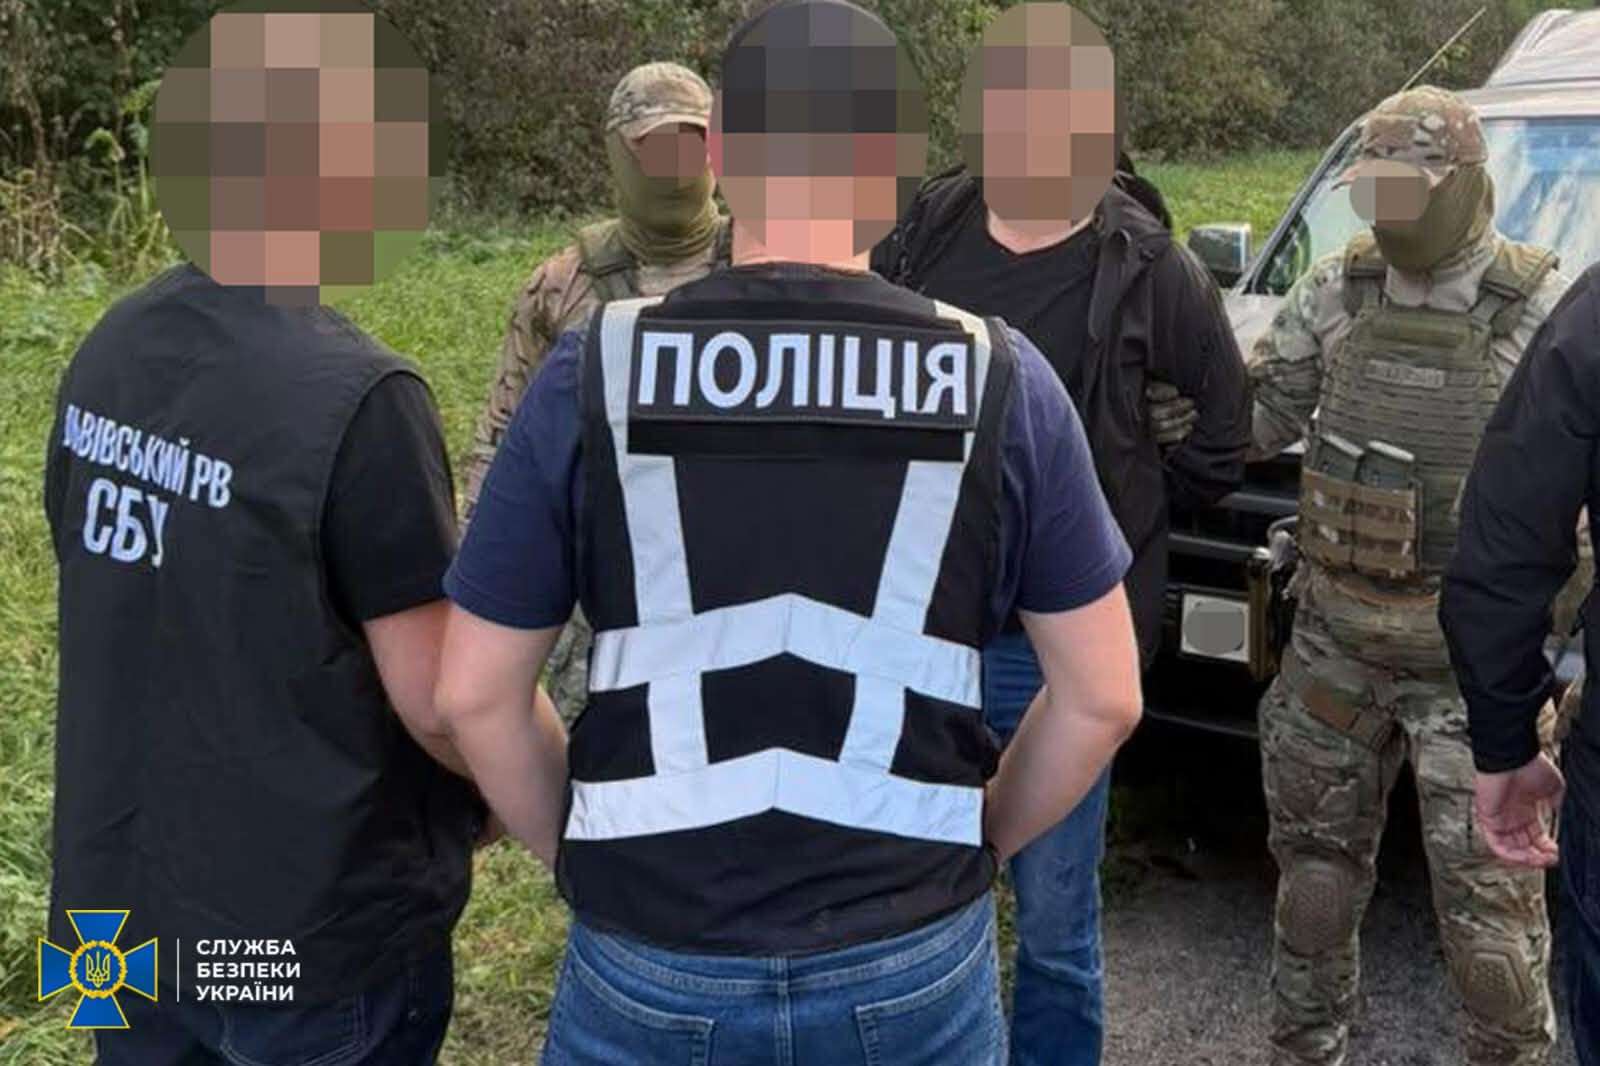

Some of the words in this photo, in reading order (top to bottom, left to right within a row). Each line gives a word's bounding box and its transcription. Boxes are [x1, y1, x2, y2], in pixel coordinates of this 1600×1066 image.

[637, 331, 968, 418] ПОЛІЦІЯ
[83, 478, 168, 568] СБУ
[189, 453, 233, 508] РВ
